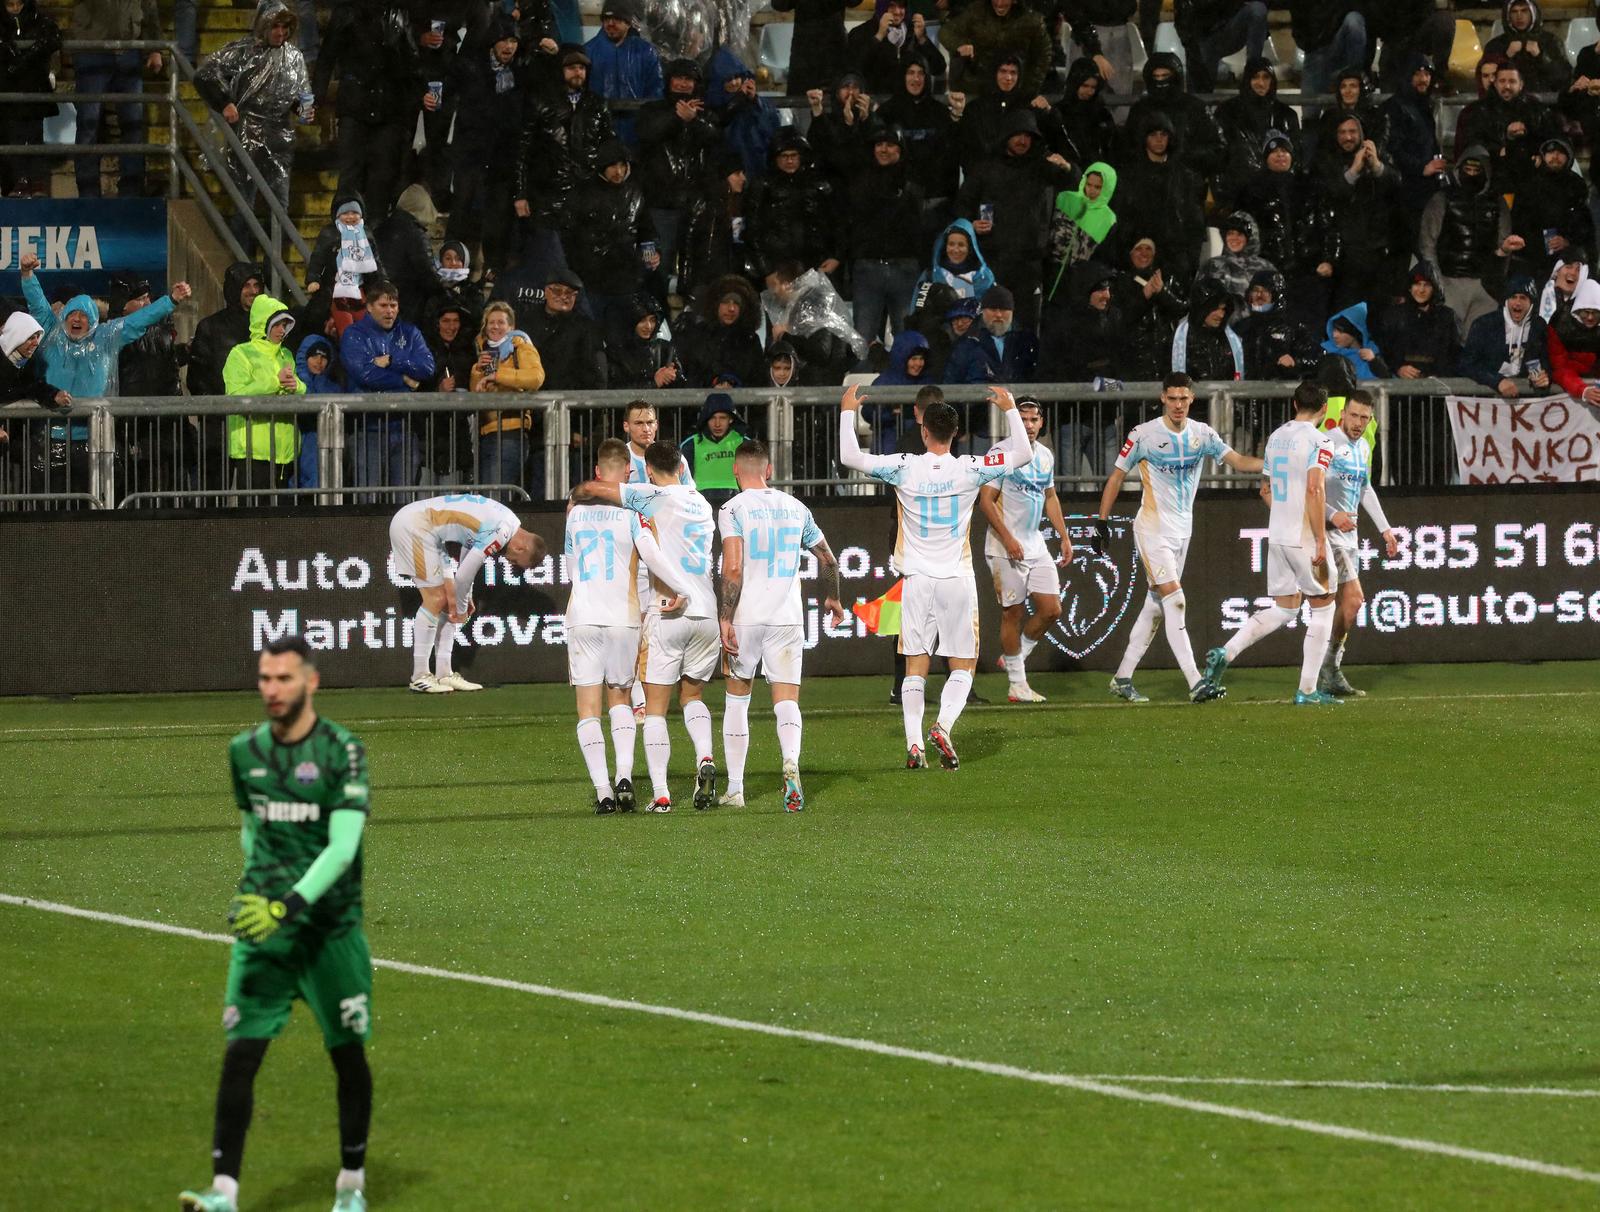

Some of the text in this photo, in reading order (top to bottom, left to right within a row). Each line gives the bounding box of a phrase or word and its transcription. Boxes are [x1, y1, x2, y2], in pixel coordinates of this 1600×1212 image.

[1457, 402, 1569, 432] NIKO
[1463, 432, 1600, 471] JANKO
[1272, 456, 1289, 502] 5
[914, 496, 959, 538] 14
[575, 529, 615, 581] 21
[751, 527, 801, 578] 45
[1494, 522, 1547, 567] 51
[1563, 522, 1600, 567] 6
[231, 547, 371, 592] Auto
